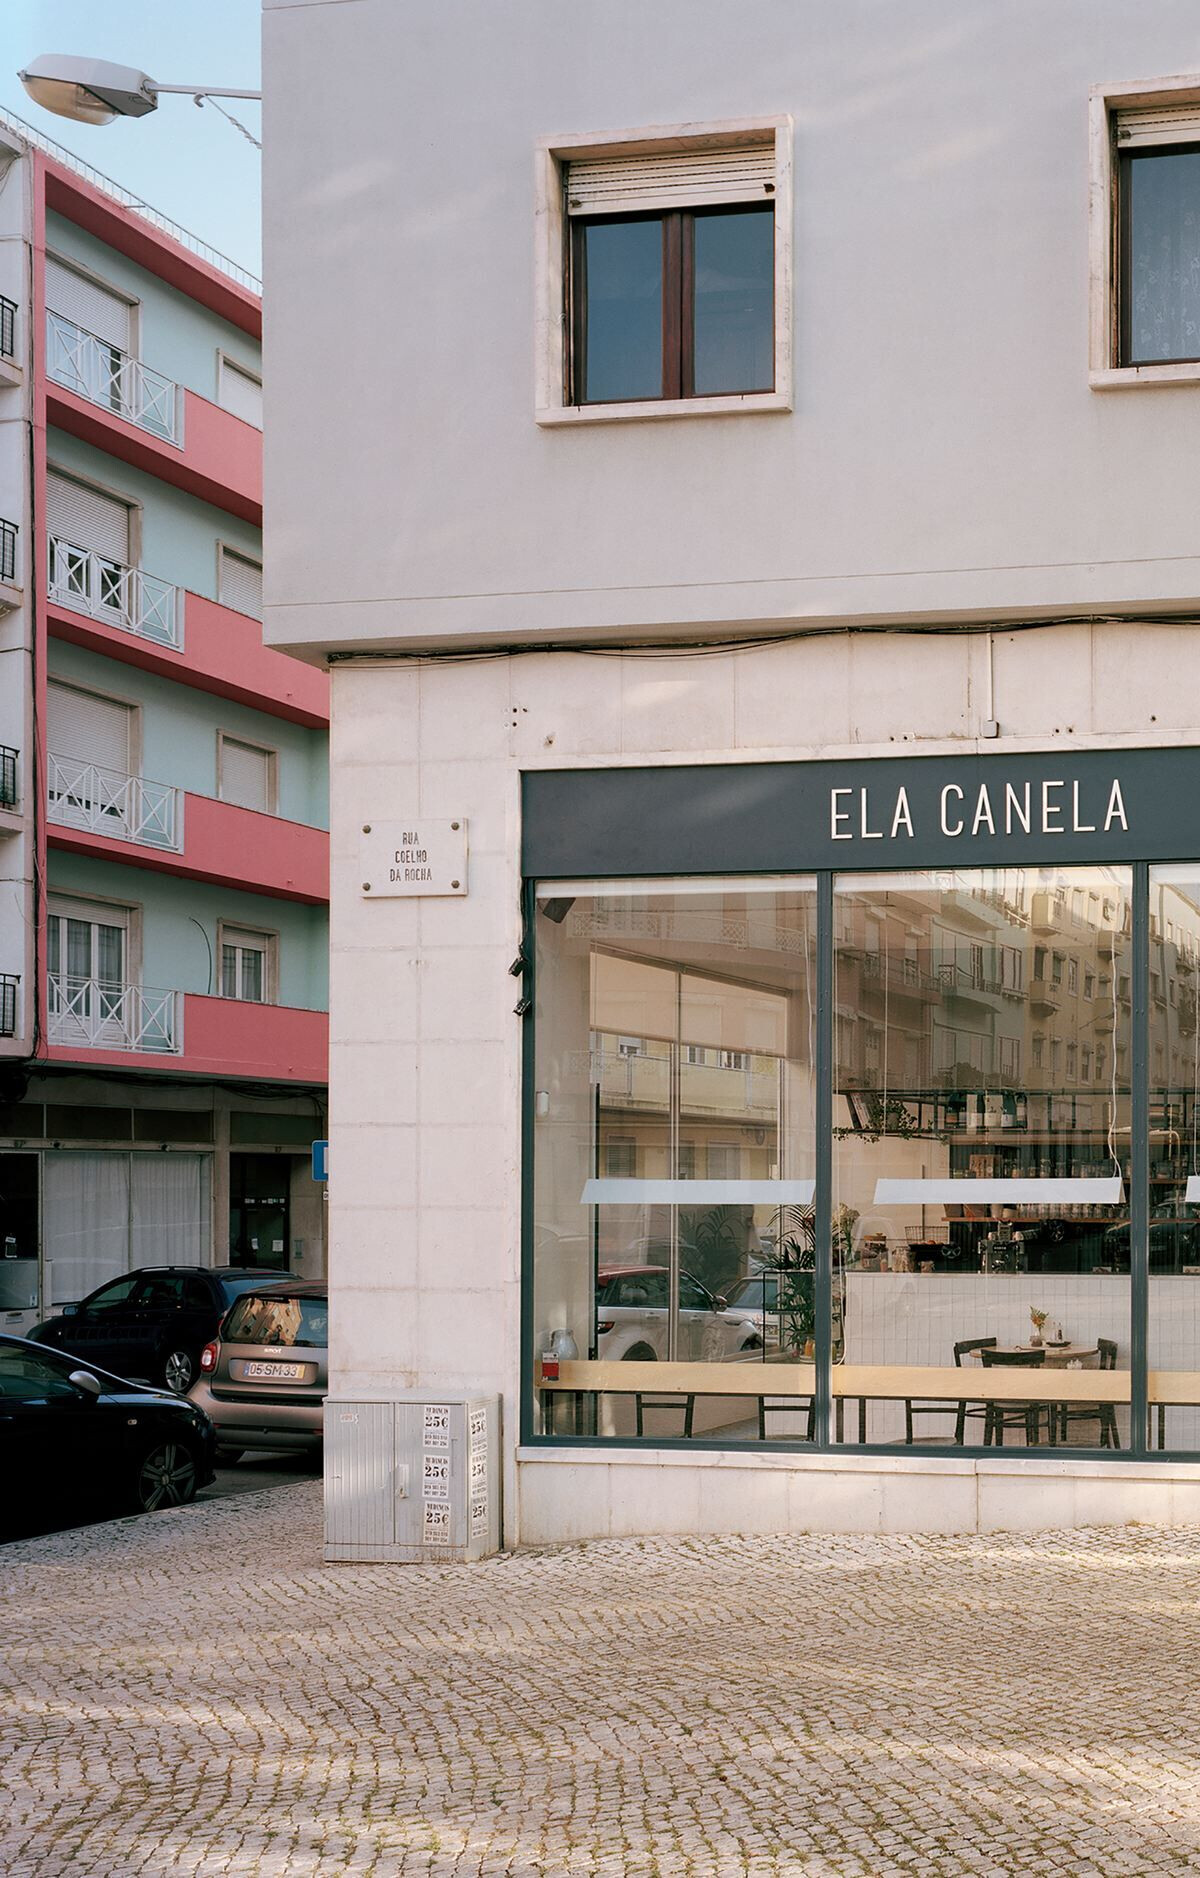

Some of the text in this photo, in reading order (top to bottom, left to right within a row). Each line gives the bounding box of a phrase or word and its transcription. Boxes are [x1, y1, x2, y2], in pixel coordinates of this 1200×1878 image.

[830, 778, 1129, 840] ELA CANELA
[402, 832, 420, 845] RUA
[395, 850, 428, 864] COELHO
[389, 868, 432, 882] DA ROCHA
[425, 1416, 449, 1428] 25€
[425, 1466, 448, 1479] 25€
[426, 1512, 449, 1525] 25€
